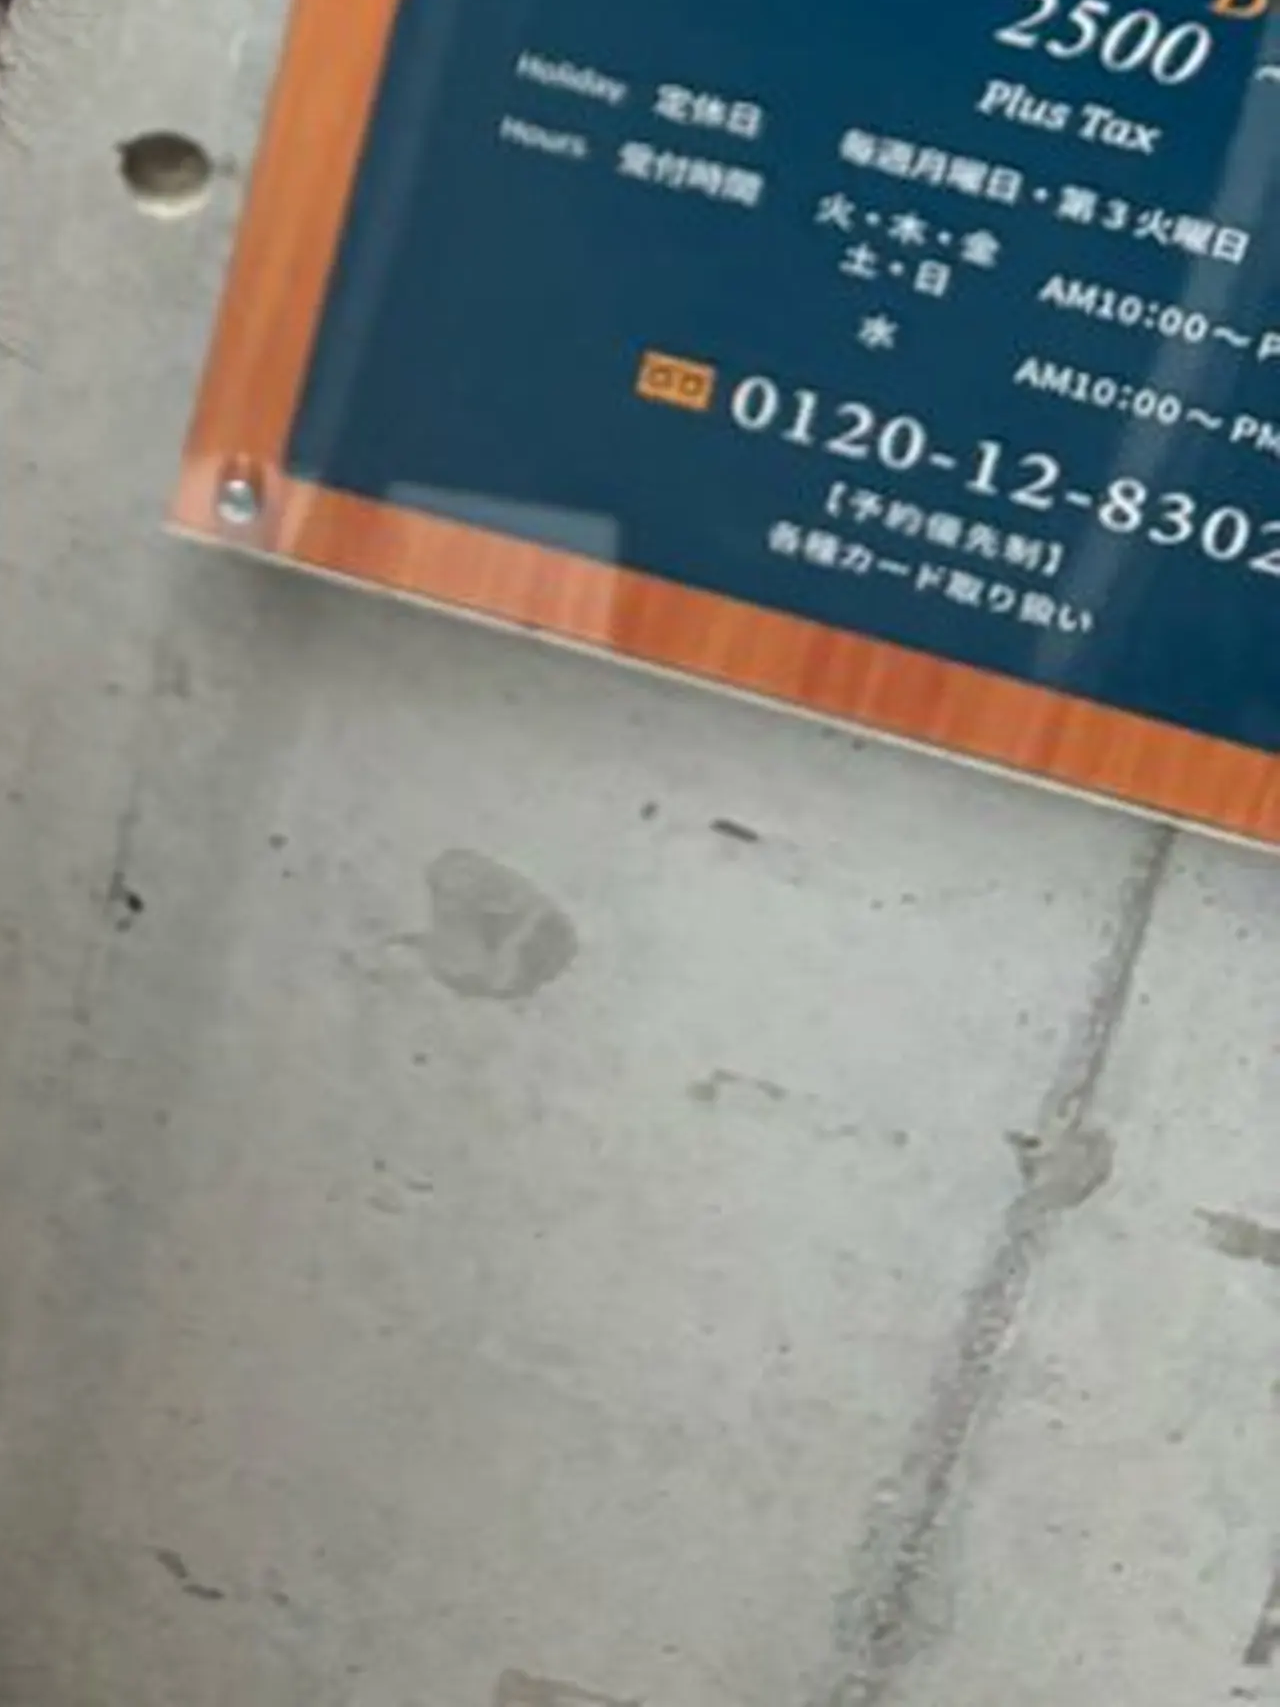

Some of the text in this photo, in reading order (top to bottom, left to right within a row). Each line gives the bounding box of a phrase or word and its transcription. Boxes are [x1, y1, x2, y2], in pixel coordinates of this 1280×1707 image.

[652, 83, 762, 139] 定休日
[975, 79, 1162, 155] Plus Tax
